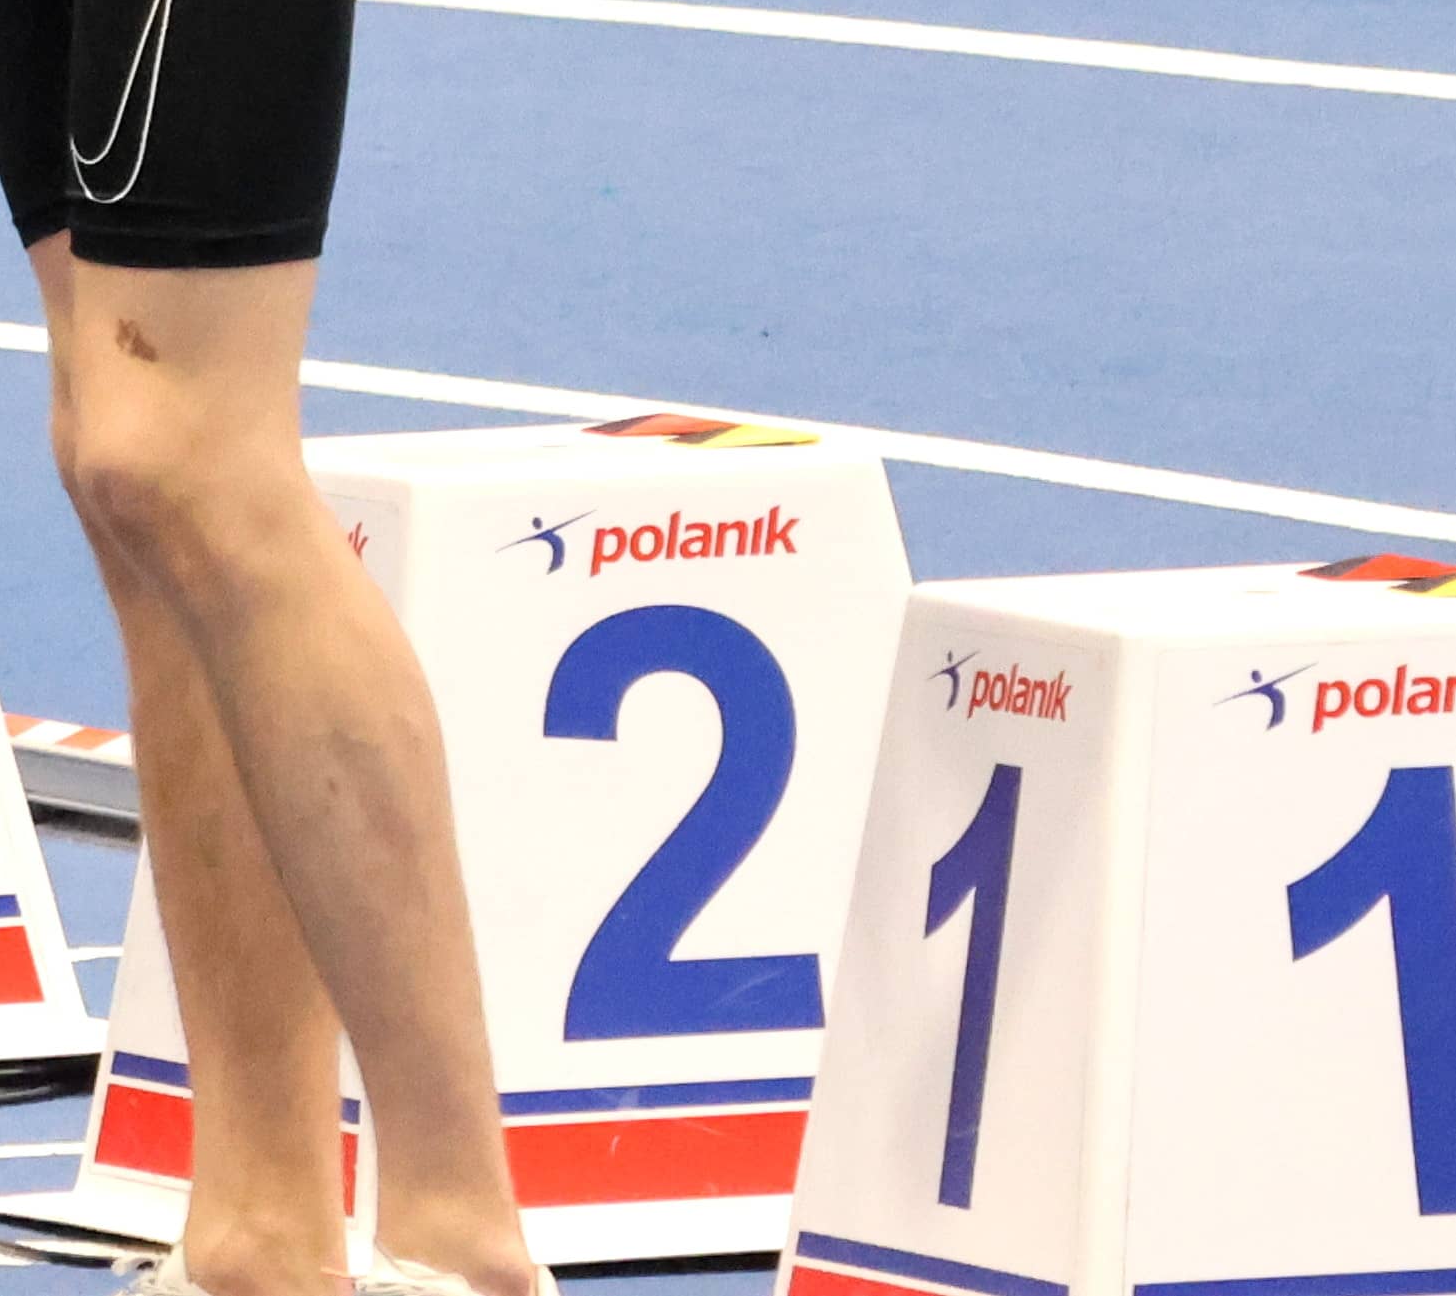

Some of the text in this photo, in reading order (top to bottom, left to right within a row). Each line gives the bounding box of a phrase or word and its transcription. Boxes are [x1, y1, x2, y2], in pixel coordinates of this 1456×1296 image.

[589, 505, 800, 578] polanik
[967, 664, 1074, 722] polanik
[543, 604, 826, 1043] 2
[925, 763, 1023, 1211] 1
[1287, 765, 1456, 1216] 1
